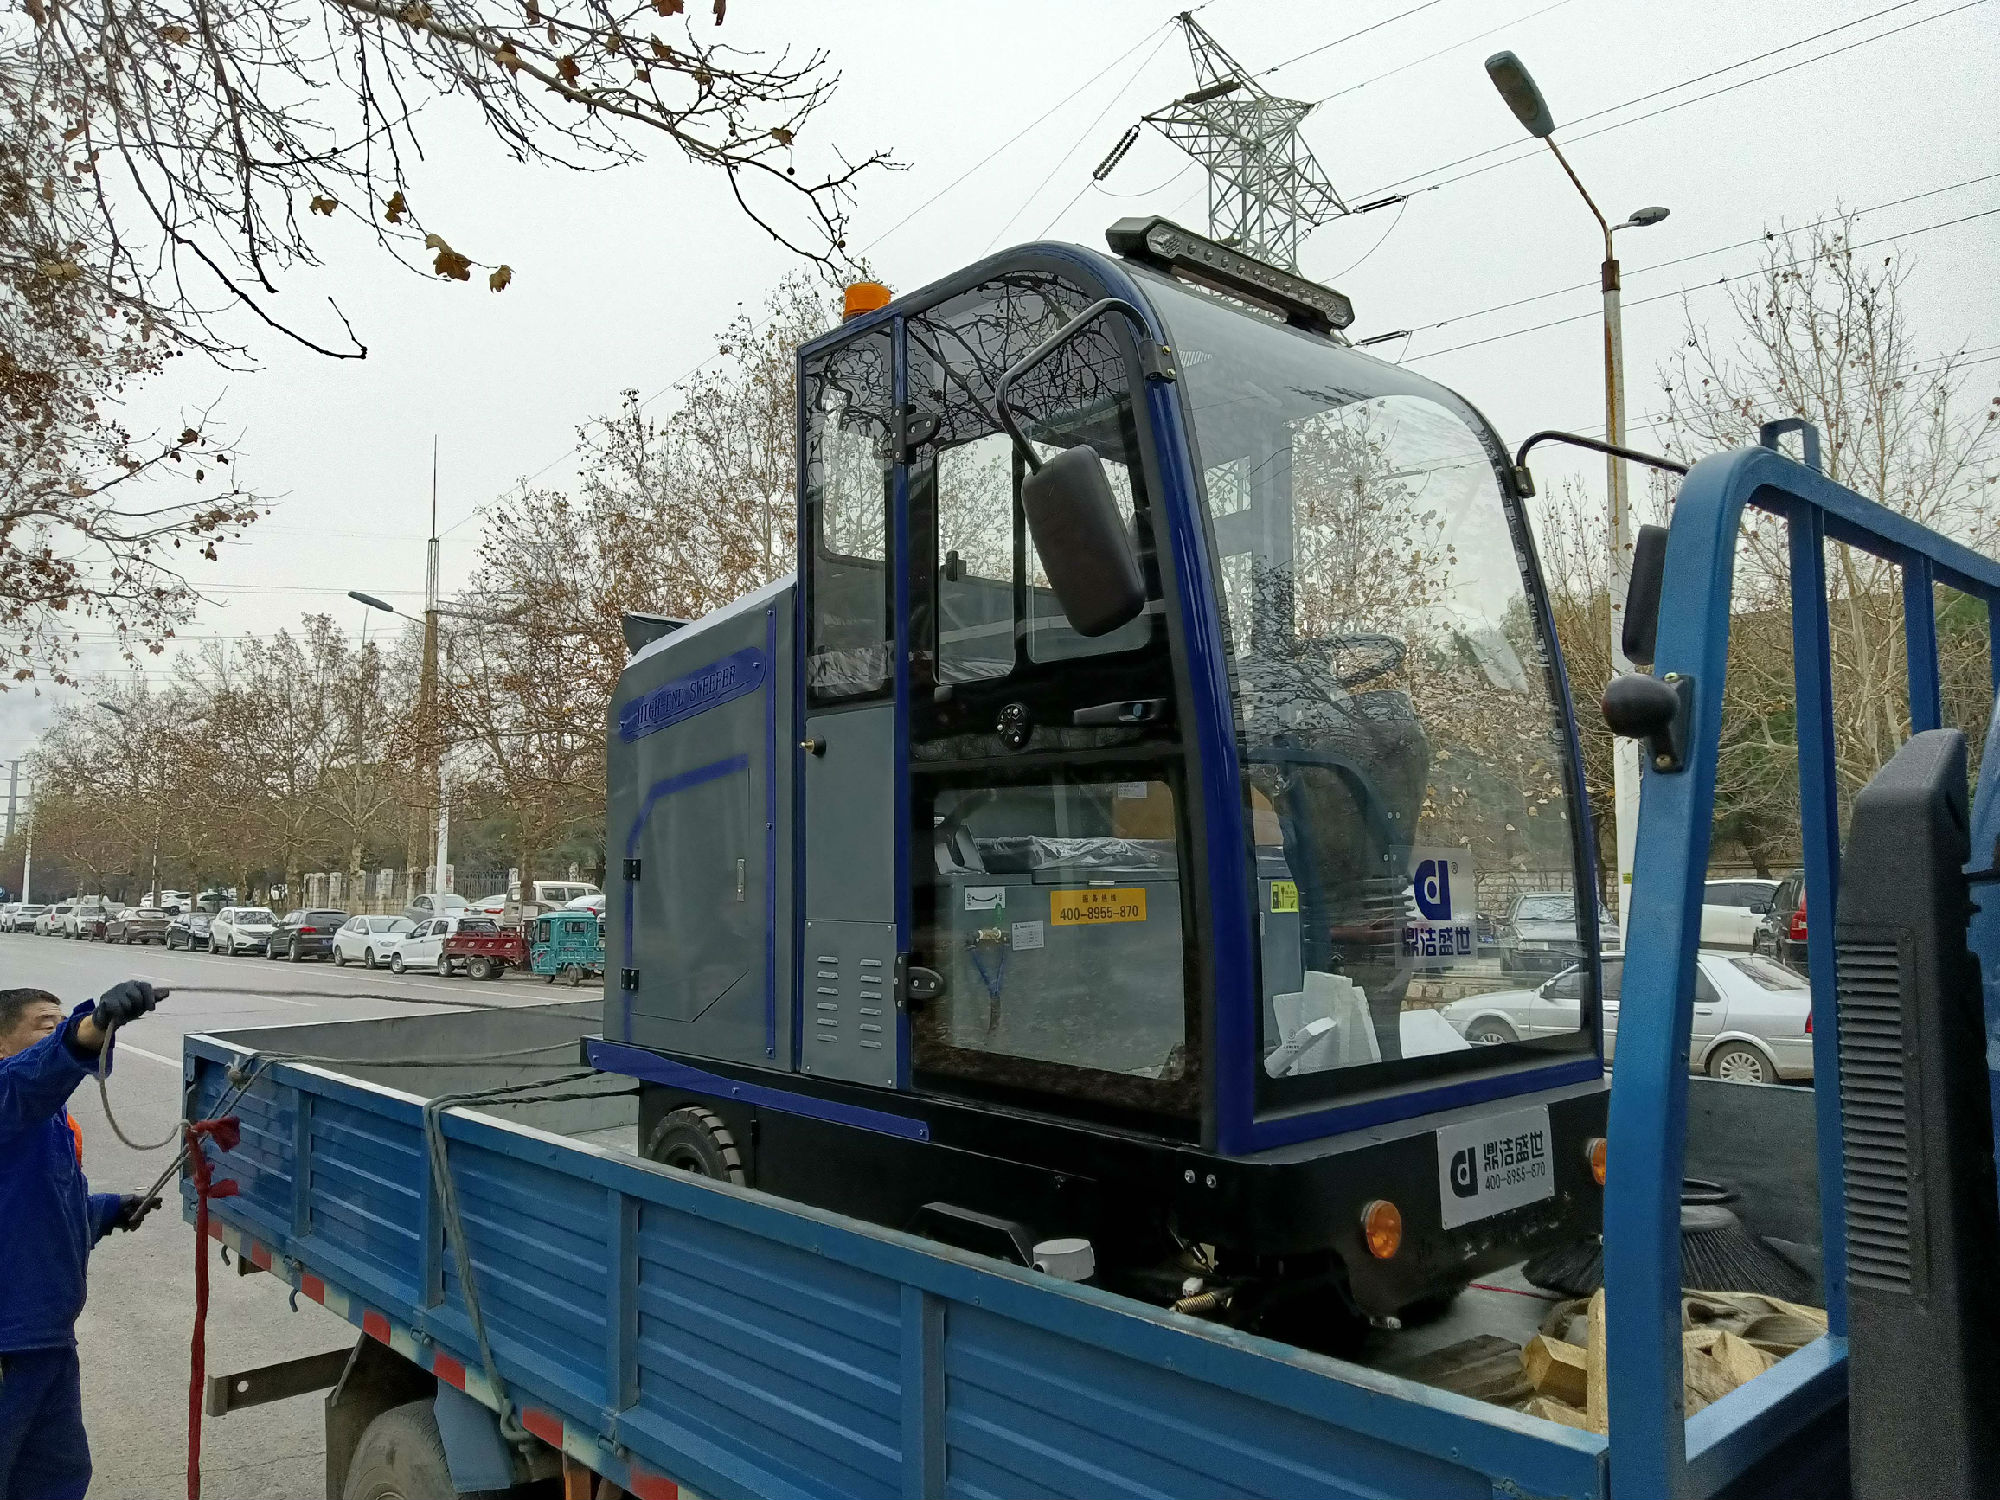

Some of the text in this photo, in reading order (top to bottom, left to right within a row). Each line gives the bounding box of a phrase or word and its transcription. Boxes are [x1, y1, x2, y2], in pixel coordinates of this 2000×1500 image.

[1060, 905, 1139, 921] 400-8955-870
[1402, 926, 1472, 956] 鼎洁盛世
[1483, 1130, 1545, 1172] 鼎洁盛世
[1485, 1161, 1546, 1191] 400-8955-870
